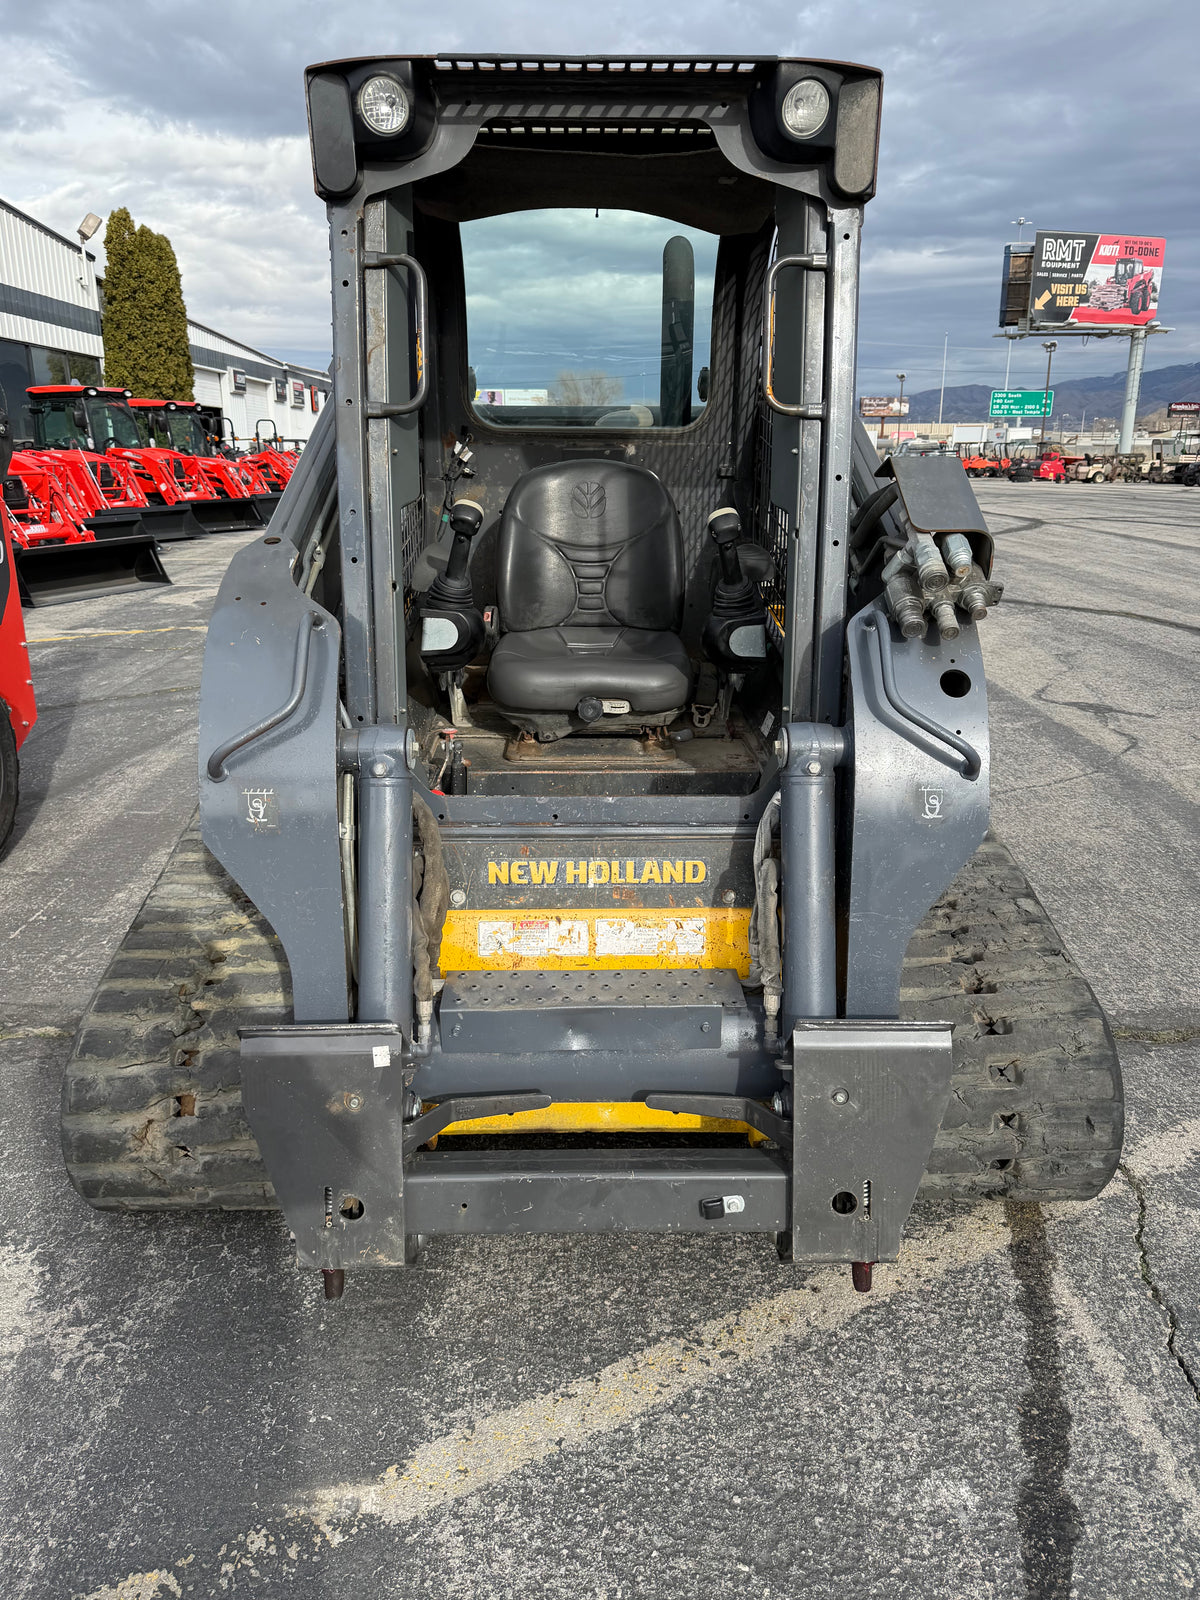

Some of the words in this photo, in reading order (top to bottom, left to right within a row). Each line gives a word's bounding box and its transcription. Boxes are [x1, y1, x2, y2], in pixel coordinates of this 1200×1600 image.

[1042, 238, 1086, 262] RMT
[1098, 244, 1120, 256] KIOTI
[1124, 246, 1160, 257] TO-DONE
[1041, 261, 1081, 269] EQUIPMENT
[1051, 283, 1075, 295] VISIT
[1075, 283, 1088, 295] US
[1056, 296, 1080, 307] HERE
[488, 860, 559, 885] NEW
[565, 860, 708, 885] HOLLAND
